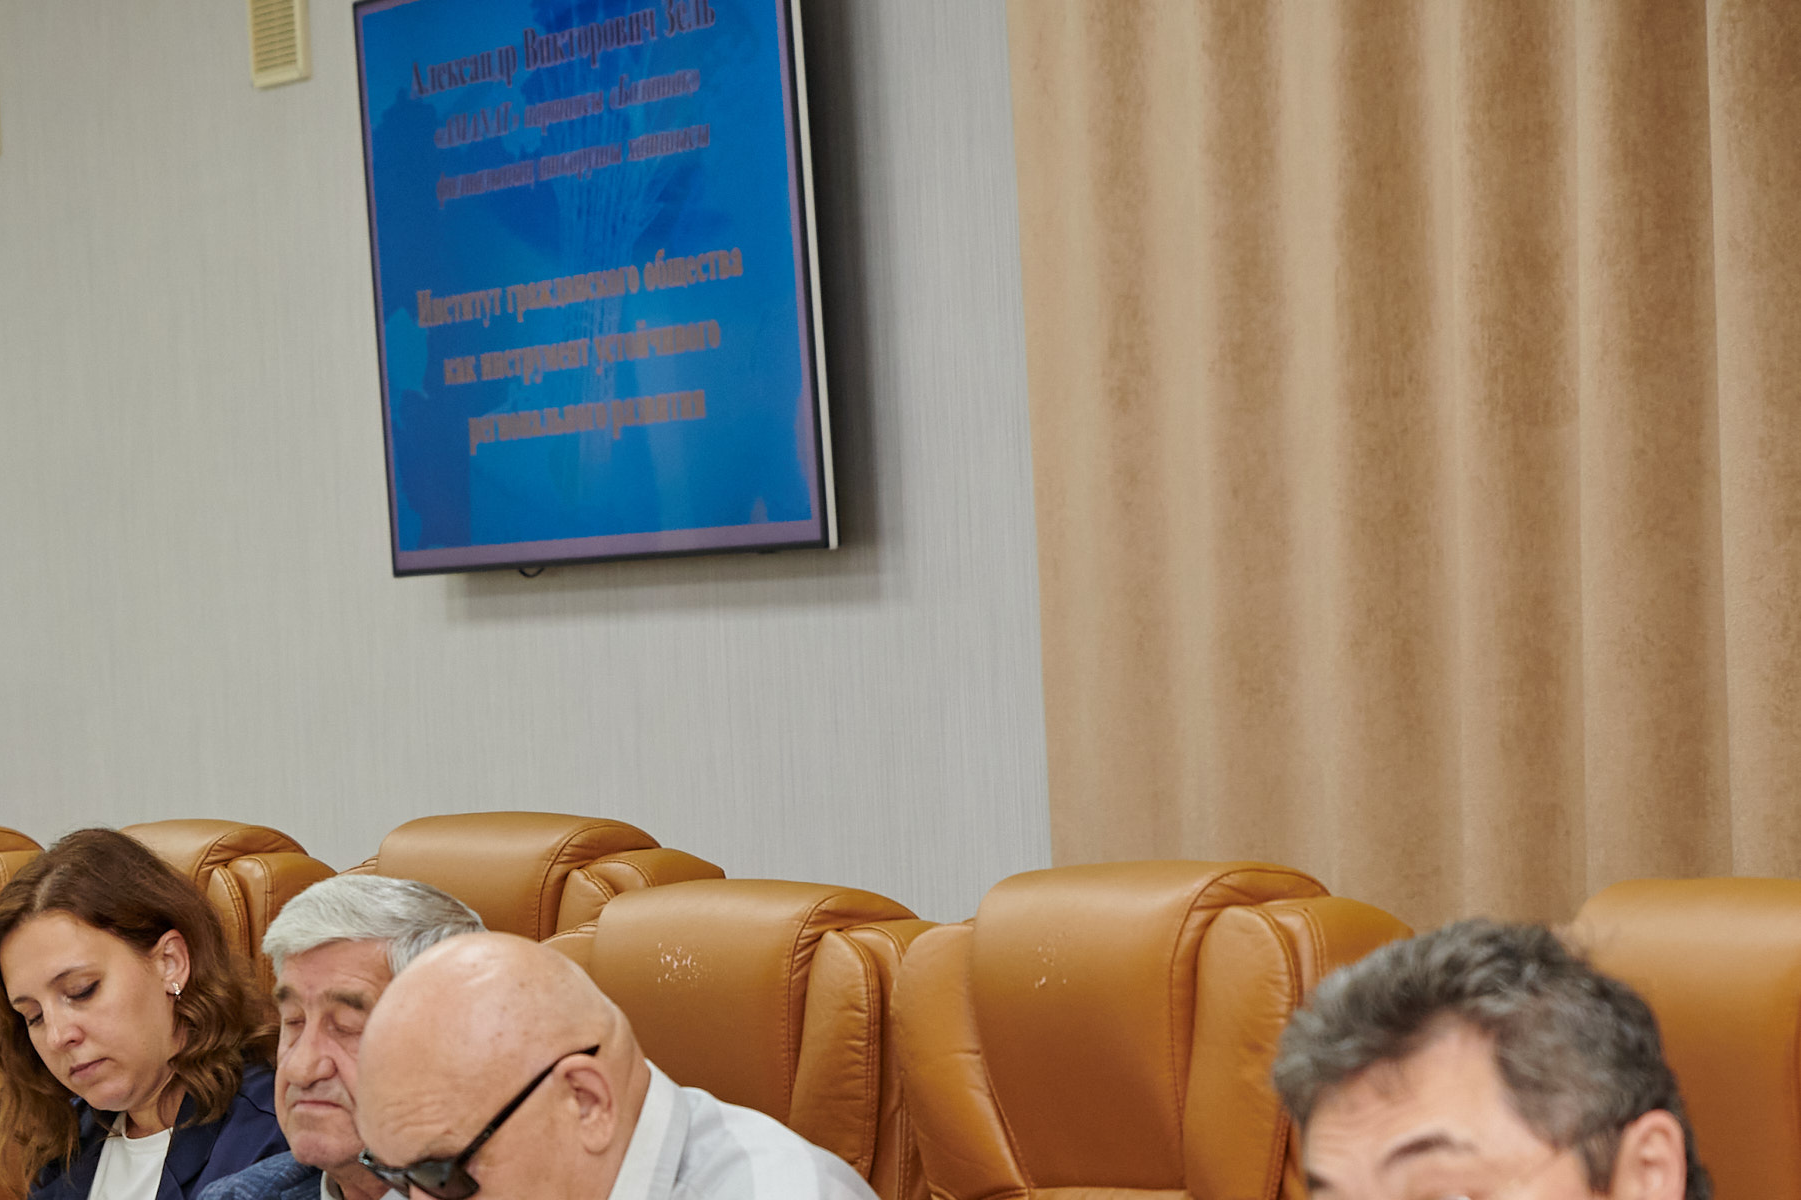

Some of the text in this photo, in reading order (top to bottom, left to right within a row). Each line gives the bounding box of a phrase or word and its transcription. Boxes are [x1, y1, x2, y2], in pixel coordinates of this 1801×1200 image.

[410, 45, 517, 99] Александр
[523, 8, 657, 69] Викторович
[416, 246, 744, 328] Институт гражданского общества
[443, 319, 721, 386] как инструмент устойчивого
[468, 389, 706, 456] регионального развития
